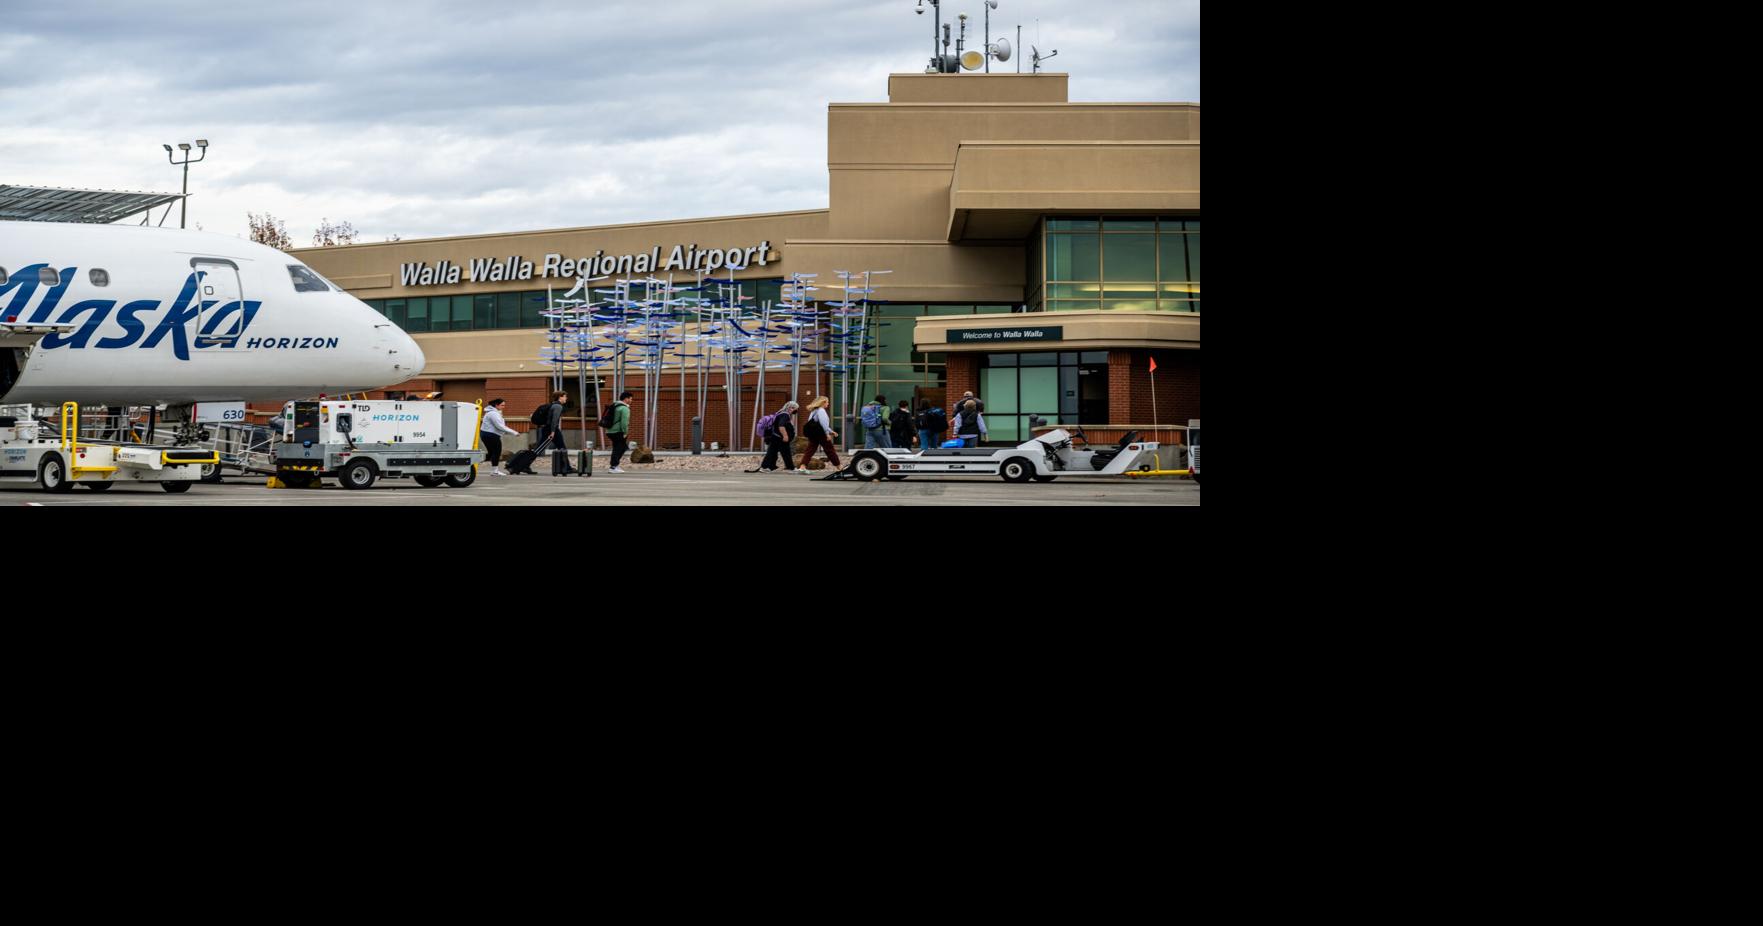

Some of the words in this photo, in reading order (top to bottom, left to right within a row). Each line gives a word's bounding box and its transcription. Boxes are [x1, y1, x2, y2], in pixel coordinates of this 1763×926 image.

[401, 261, 461, 286] Walla
[470, 256, 535, 283] Walla
[542, 246, 661, 283] Regional
[664, 240, 770, 275] Airport
[0, 263, 262, 360] Alaska
[248, 337, 338, 349] HORIZON
[223, 410, 244, 419] 630
